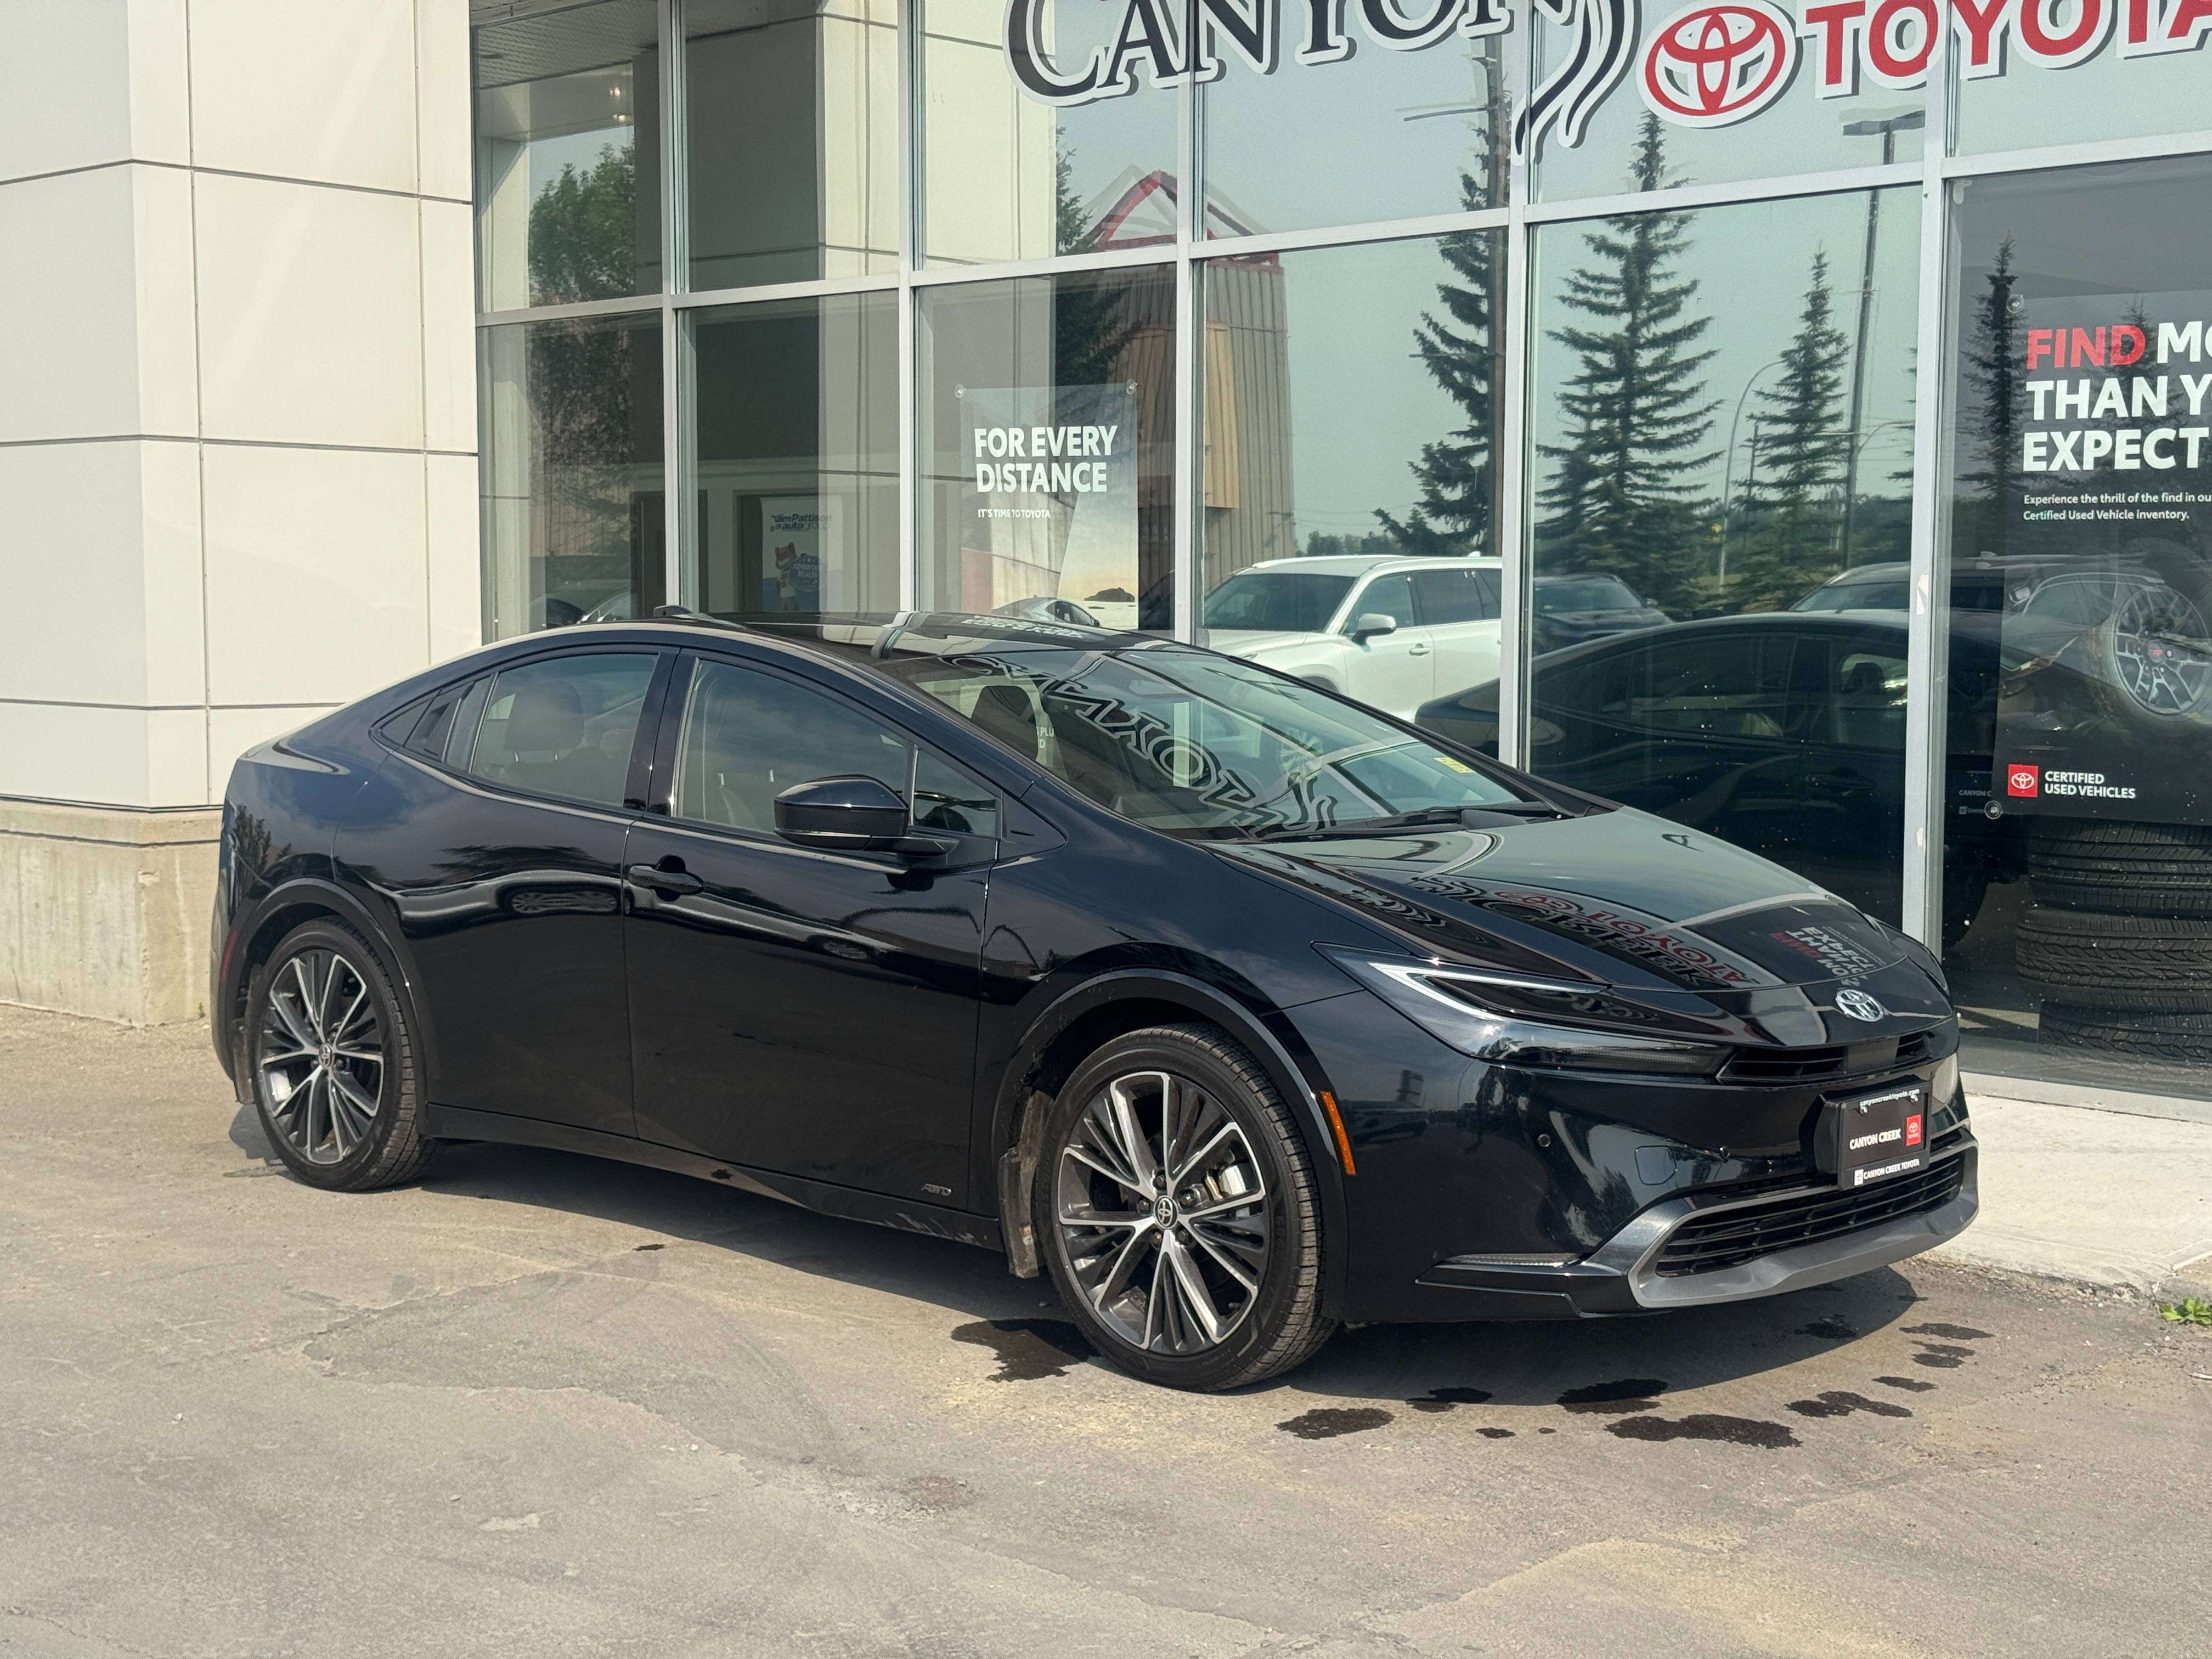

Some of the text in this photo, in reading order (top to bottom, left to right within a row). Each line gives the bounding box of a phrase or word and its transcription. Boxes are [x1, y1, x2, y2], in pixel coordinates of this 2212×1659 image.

[1004, 0, 1573, 106] CAN
[2026, 325, 2146, 370] FIND
[2026, 375, 2168, 420] THAN
[974, 425, 1118, 458] FOR EVERY
[2023, 427, 2210, 471] EXPECT
[976, 462, 1107, 493] DISTANCE
[2024, 494, 2079, 506] Experience
[2080, 494, 2098, 504] the
[2100, 493, 2125, 504] thrill
[2128, 493, 2140, 503] of
[2141, 493, 2159, 503] the
[2161, 492, 2183, 503] find
[2185, 492, 2195, 503] in
[978, 509, 1051, 518] IT'S TIME TO TOYOTA
[2023, 510, 2066, 521] Certified
[2068, 509, 2094, 520] Used
[2096, 509, 2134, 520] Vehicle
[2045, 771, 2104, 785] CERTIFIED
[2045, 783, 2136, 799] USED VEHICLES
[1849, 1133, 1878, 1150] CANYON
[1878, 1128, 1901, 1142] CREEK
[1864, 1167, 1884, 1180] CANYON
[1885, 1164, 1901, 1174] CREEK
[1901, 1159, 1920, 1170] TOYOTA
